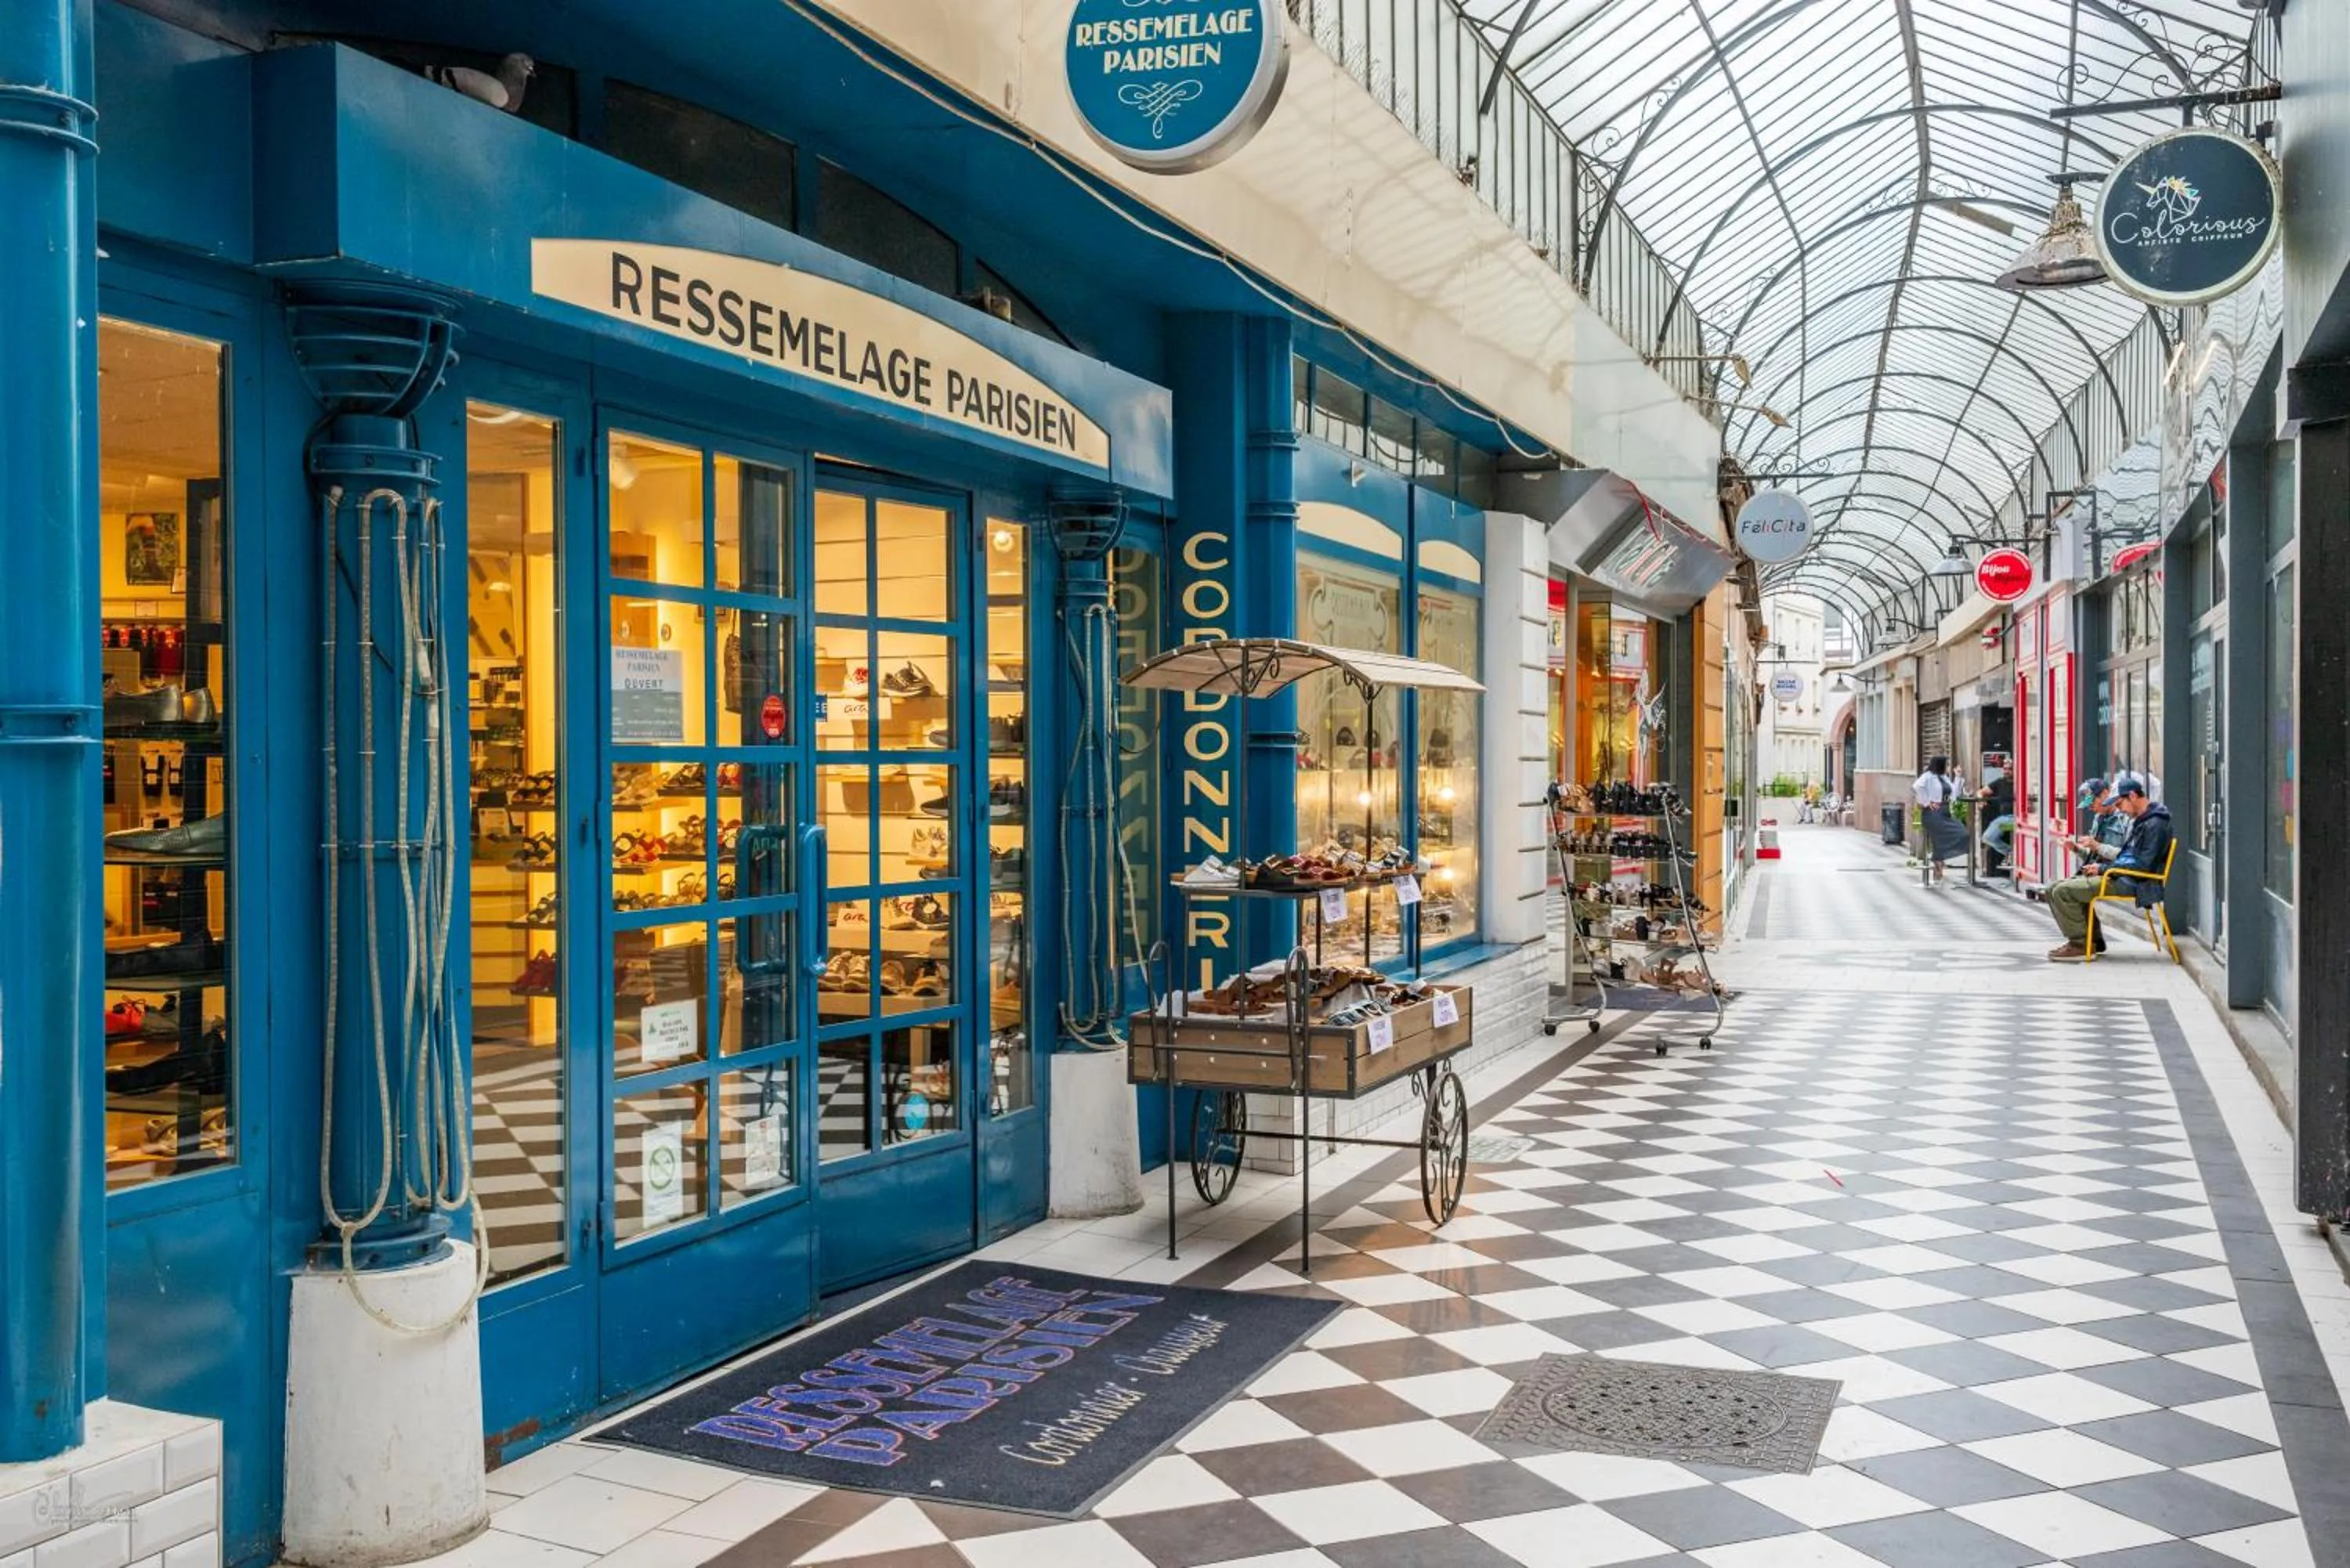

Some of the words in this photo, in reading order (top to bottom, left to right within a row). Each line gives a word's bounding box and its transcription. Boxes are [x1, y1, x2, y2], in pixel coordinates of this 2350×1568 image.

[1076, 9, 1253, 47] RESSEMELAGE
[1104, 41, 1222, 74] PARISIEN
[2111, 208, 2266, 244] Colorious
[612, 251, 932, 407] RESSEMELAGE
[947, 368, 1076, 452] PARISIEN
[689, 1276, 1089, 1451] RESSEMELAGE
[805, 1290, 1166, 1467] PARISIEN
[999, 1380, 1148, 1466] Cordonnier
